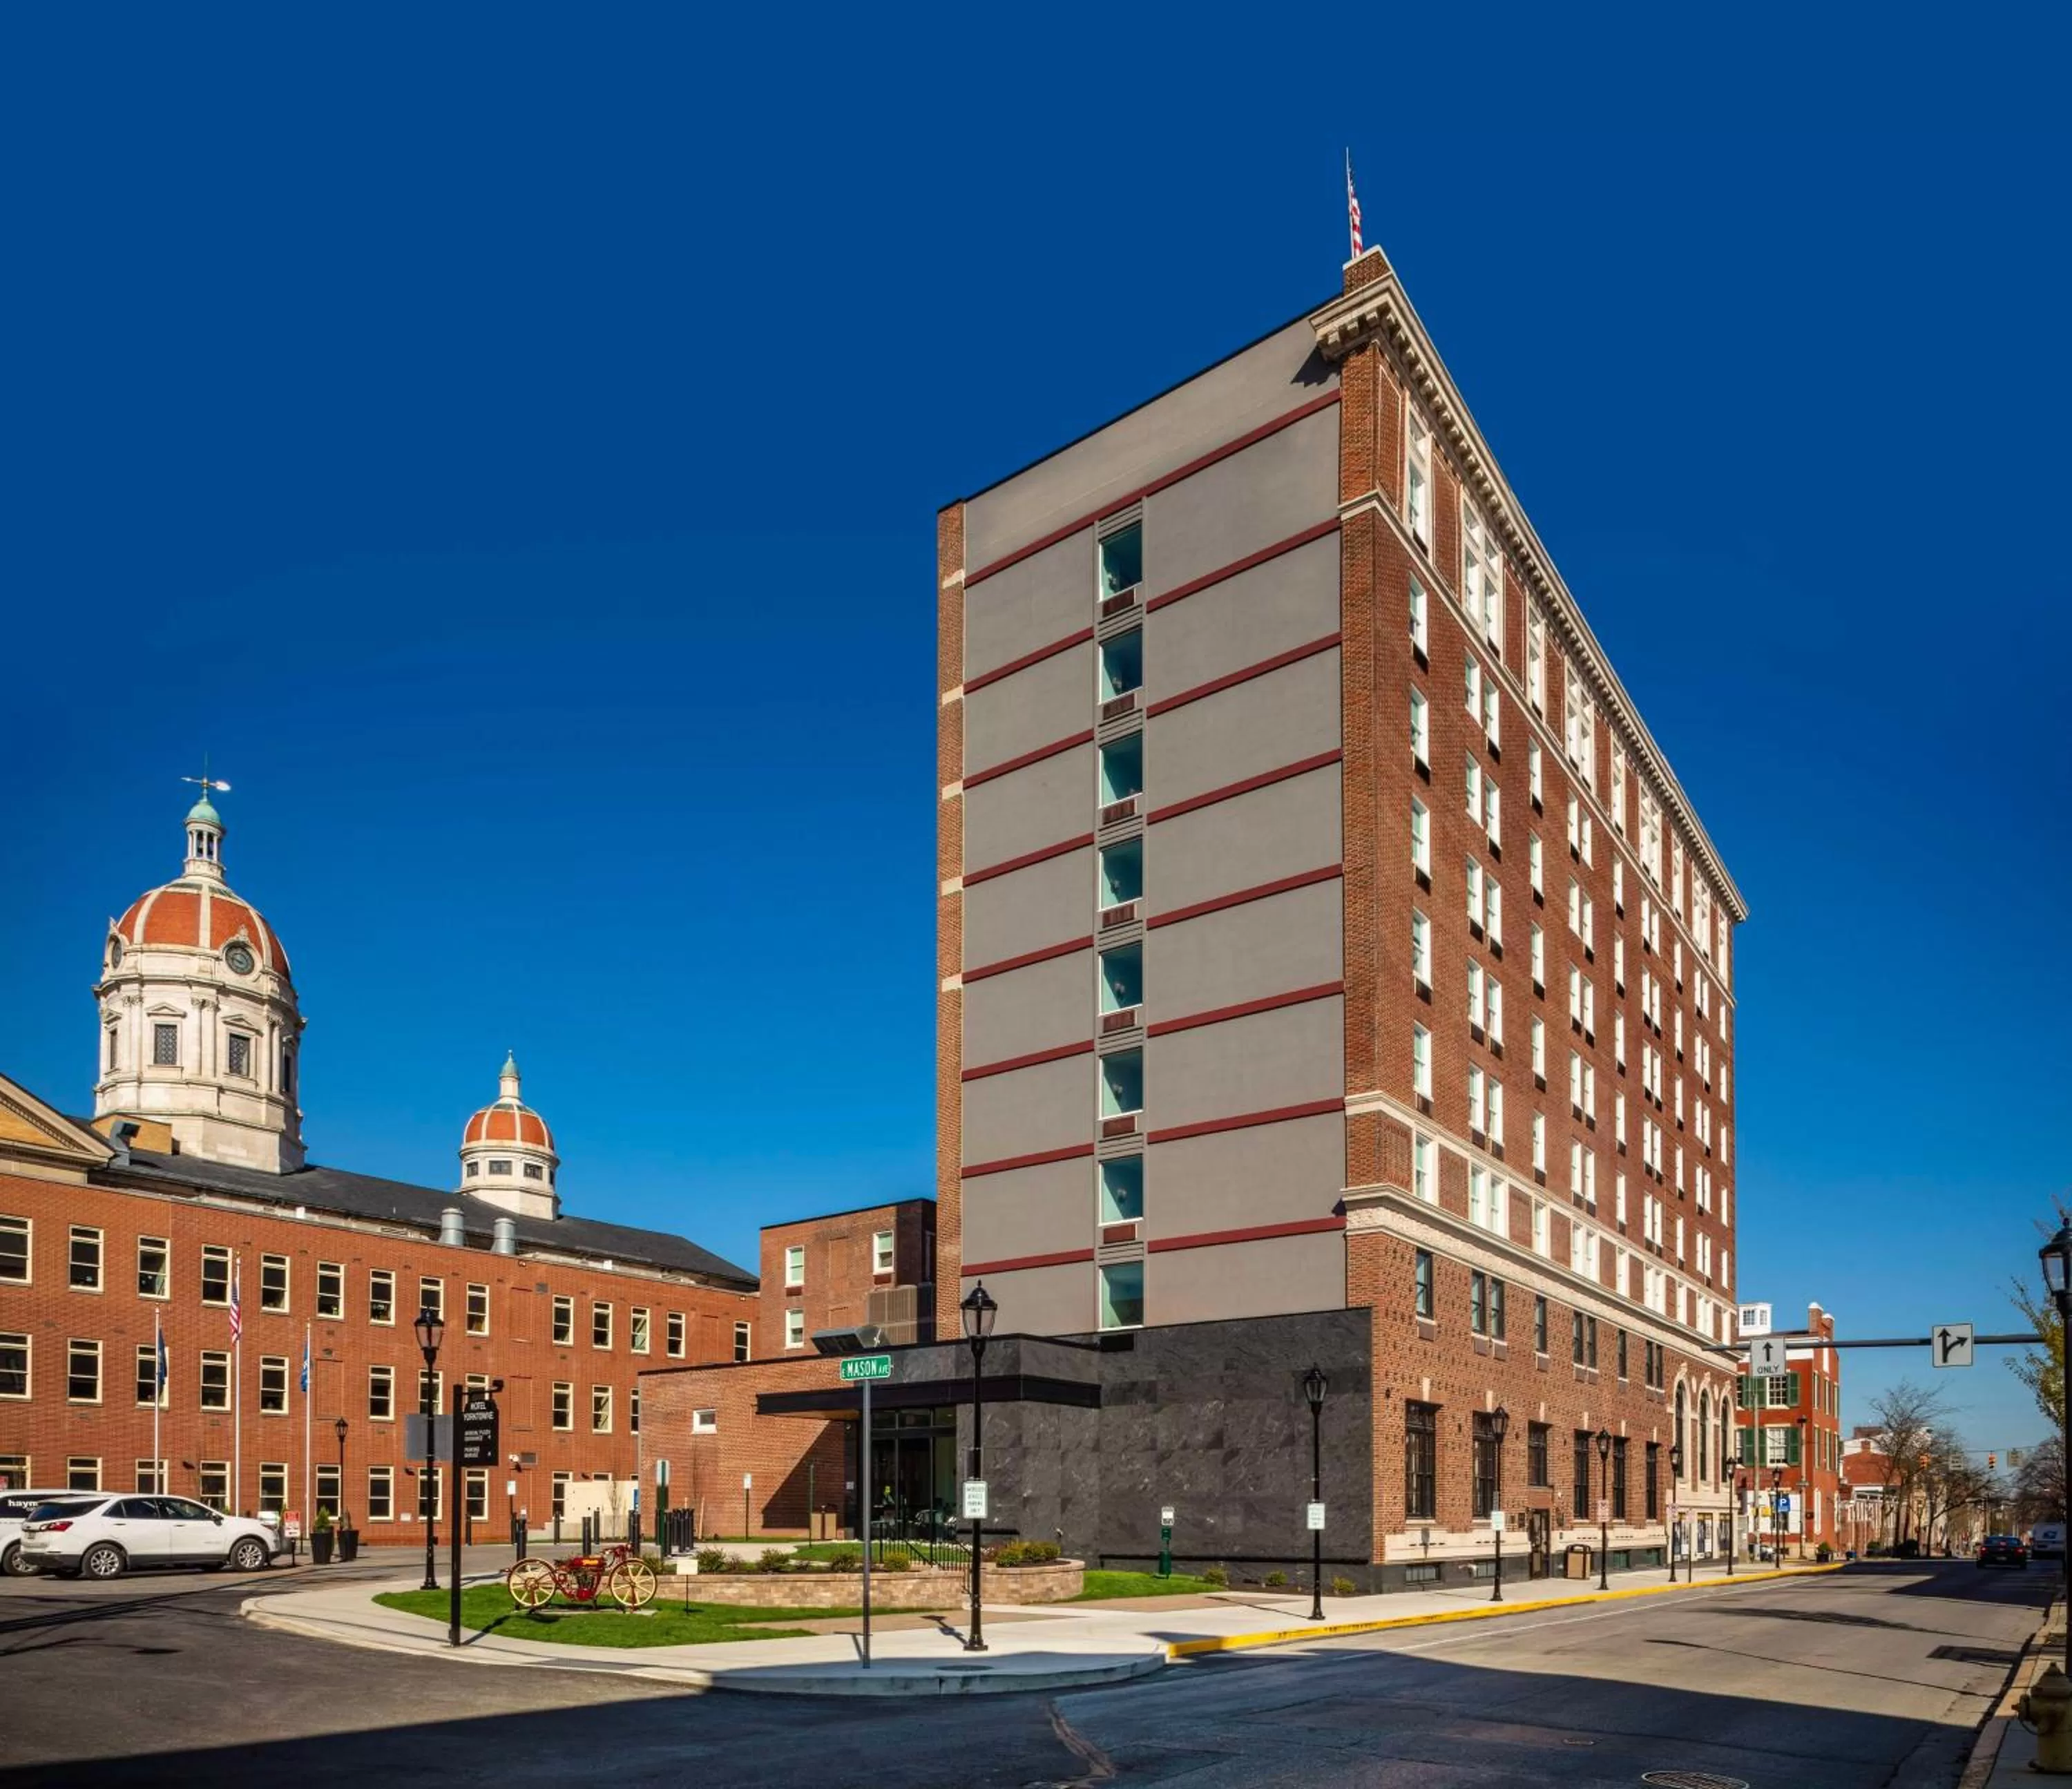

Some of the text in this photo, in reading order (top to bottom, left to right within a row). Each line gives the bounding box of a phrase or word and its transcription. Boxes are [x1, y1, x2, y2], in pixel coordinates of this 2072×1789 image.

[847, 1359, 877, 1377] MASON
[878, 1364, 889, 1375] AVE
[1756, 1364, 1780, 1374] ONLY
[470, 1401, 486, 1410] HOTEL
[8, 1500, 39, 1509] haym
[1780, 1498, 1787, 1506] P
